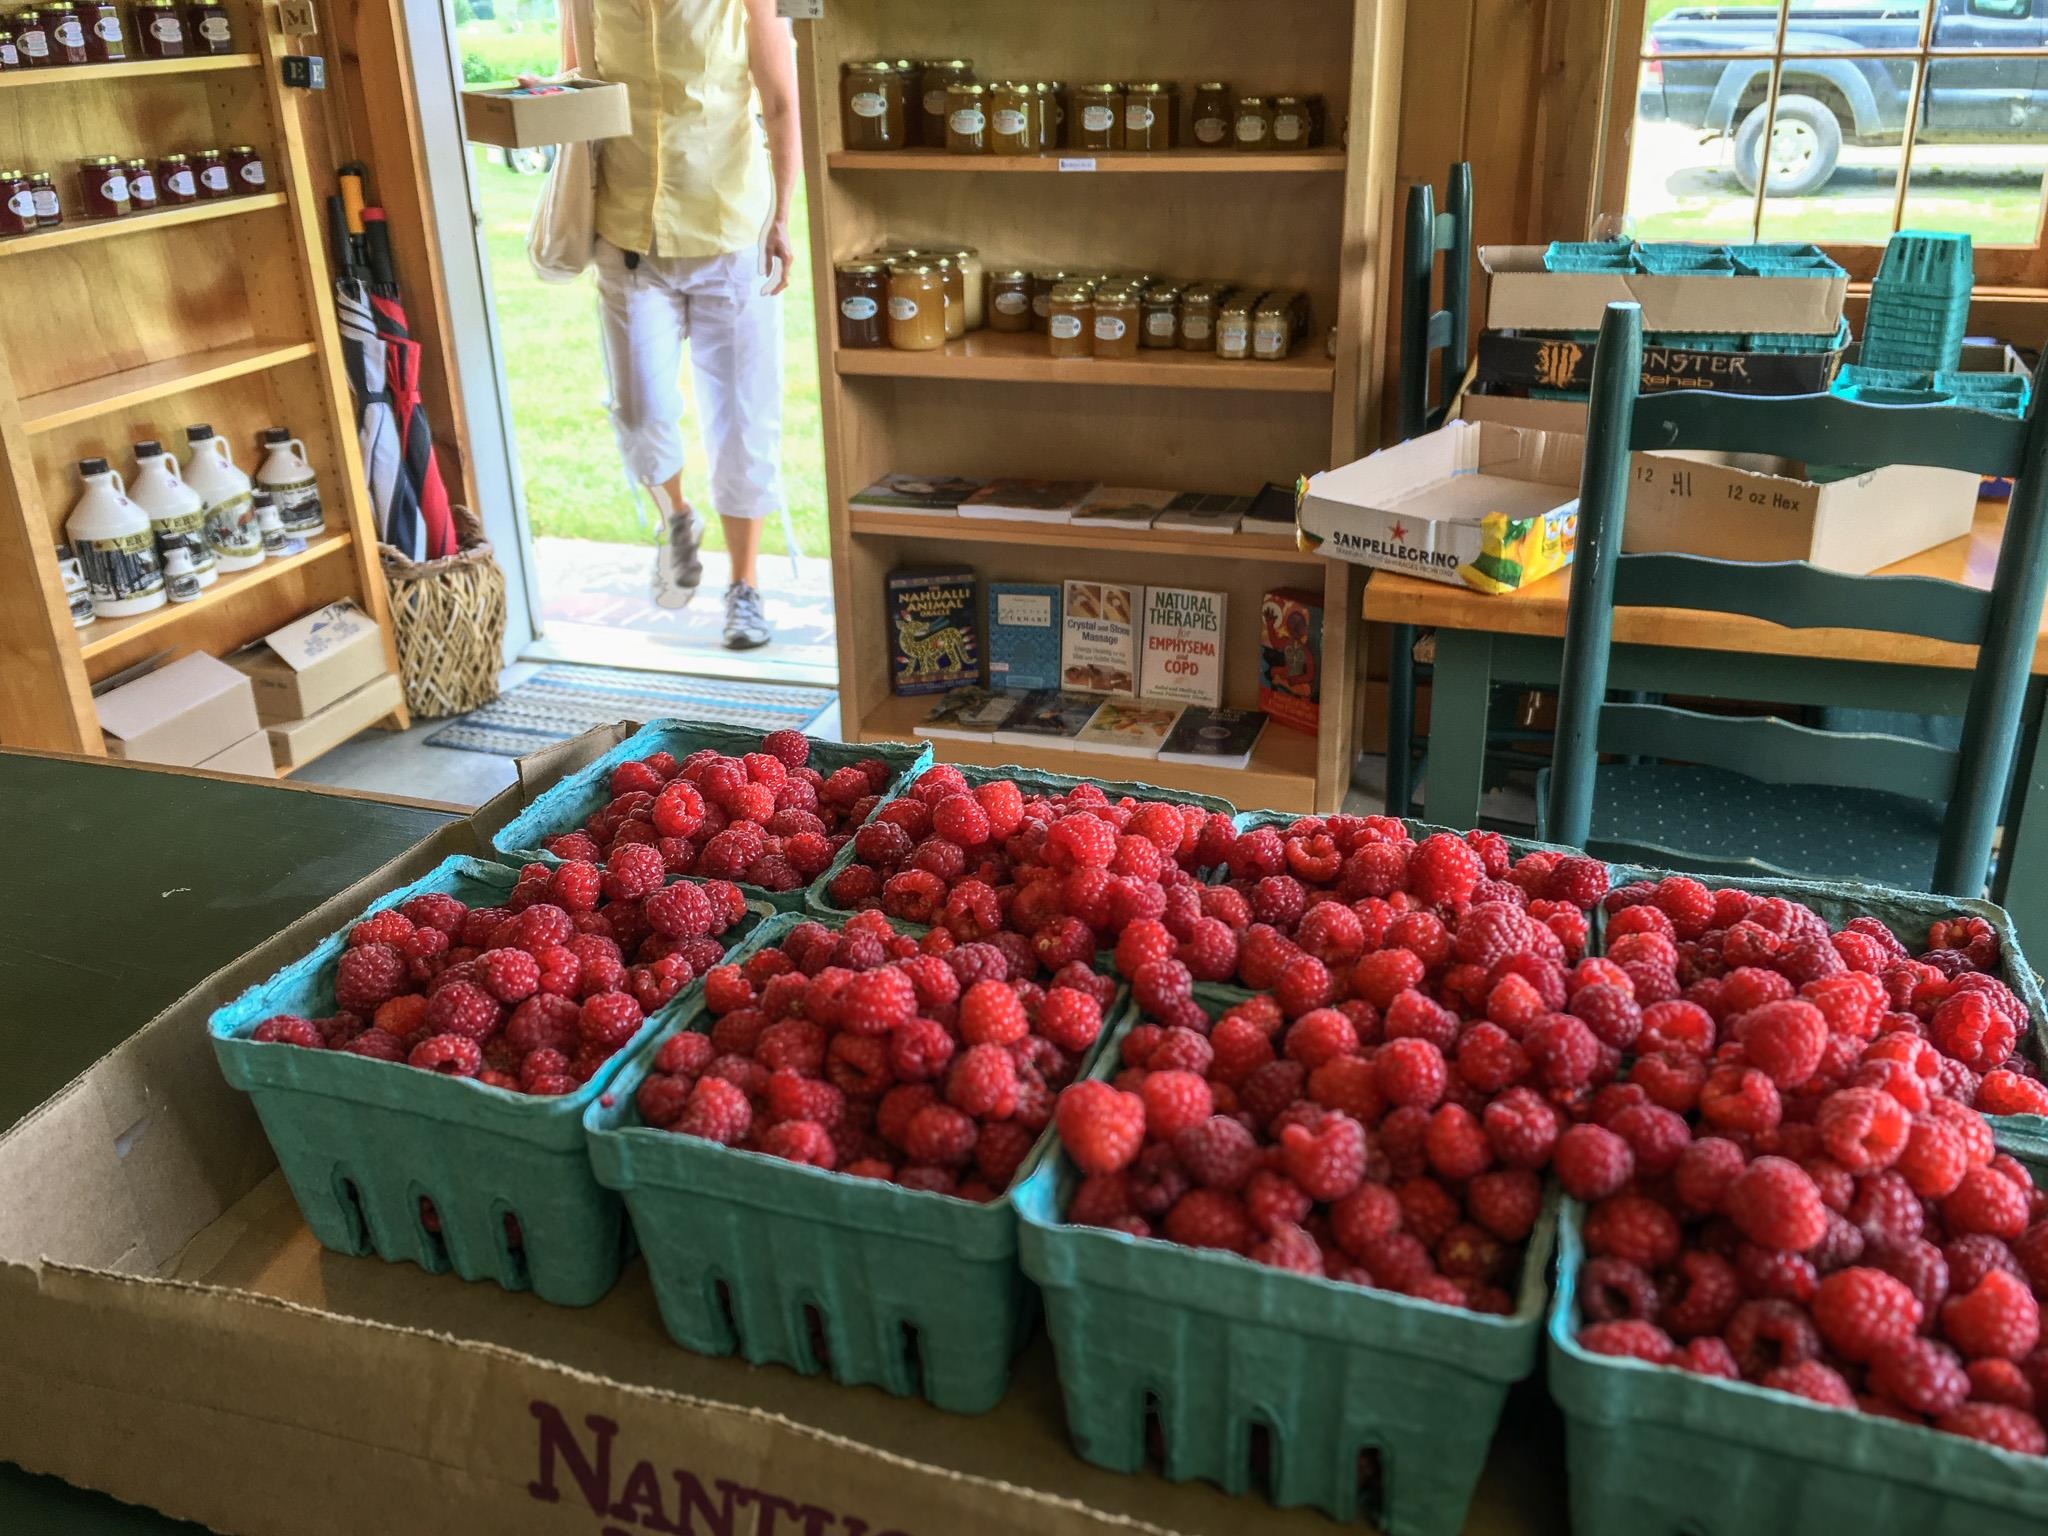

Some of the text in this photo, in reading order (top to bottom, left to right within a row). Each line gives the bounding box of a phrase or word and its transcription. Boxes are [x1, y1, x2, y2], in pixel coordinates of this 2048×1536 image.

[1641, 350, 1748, 377] NSTER
[1636, 466, 1654, 483] 12
[1727, 484, 1744, 501] 12
[1748, 492, 1766, 505] oz
[1772, 492, 1800, 512] Hex
[1332, 531, 1459, 569] SANPELLEGRINO
[898, 588, 971, 603] NAHUALLI
[906, 599, 964, 612] ANIMAL
[1155, 591, 1214, 615] NATURAL
[1067, 619, 1097, 632] Crystal
[1149, 607, 1217, 632] THERAPIES
[1082, 631, 1119, 645] Massage
[1148, 636, 1216, 656] EMPHYSEMA
[1164, 660, 1199, 676] COPD
[529, 1400, 914, 1536] NANT
